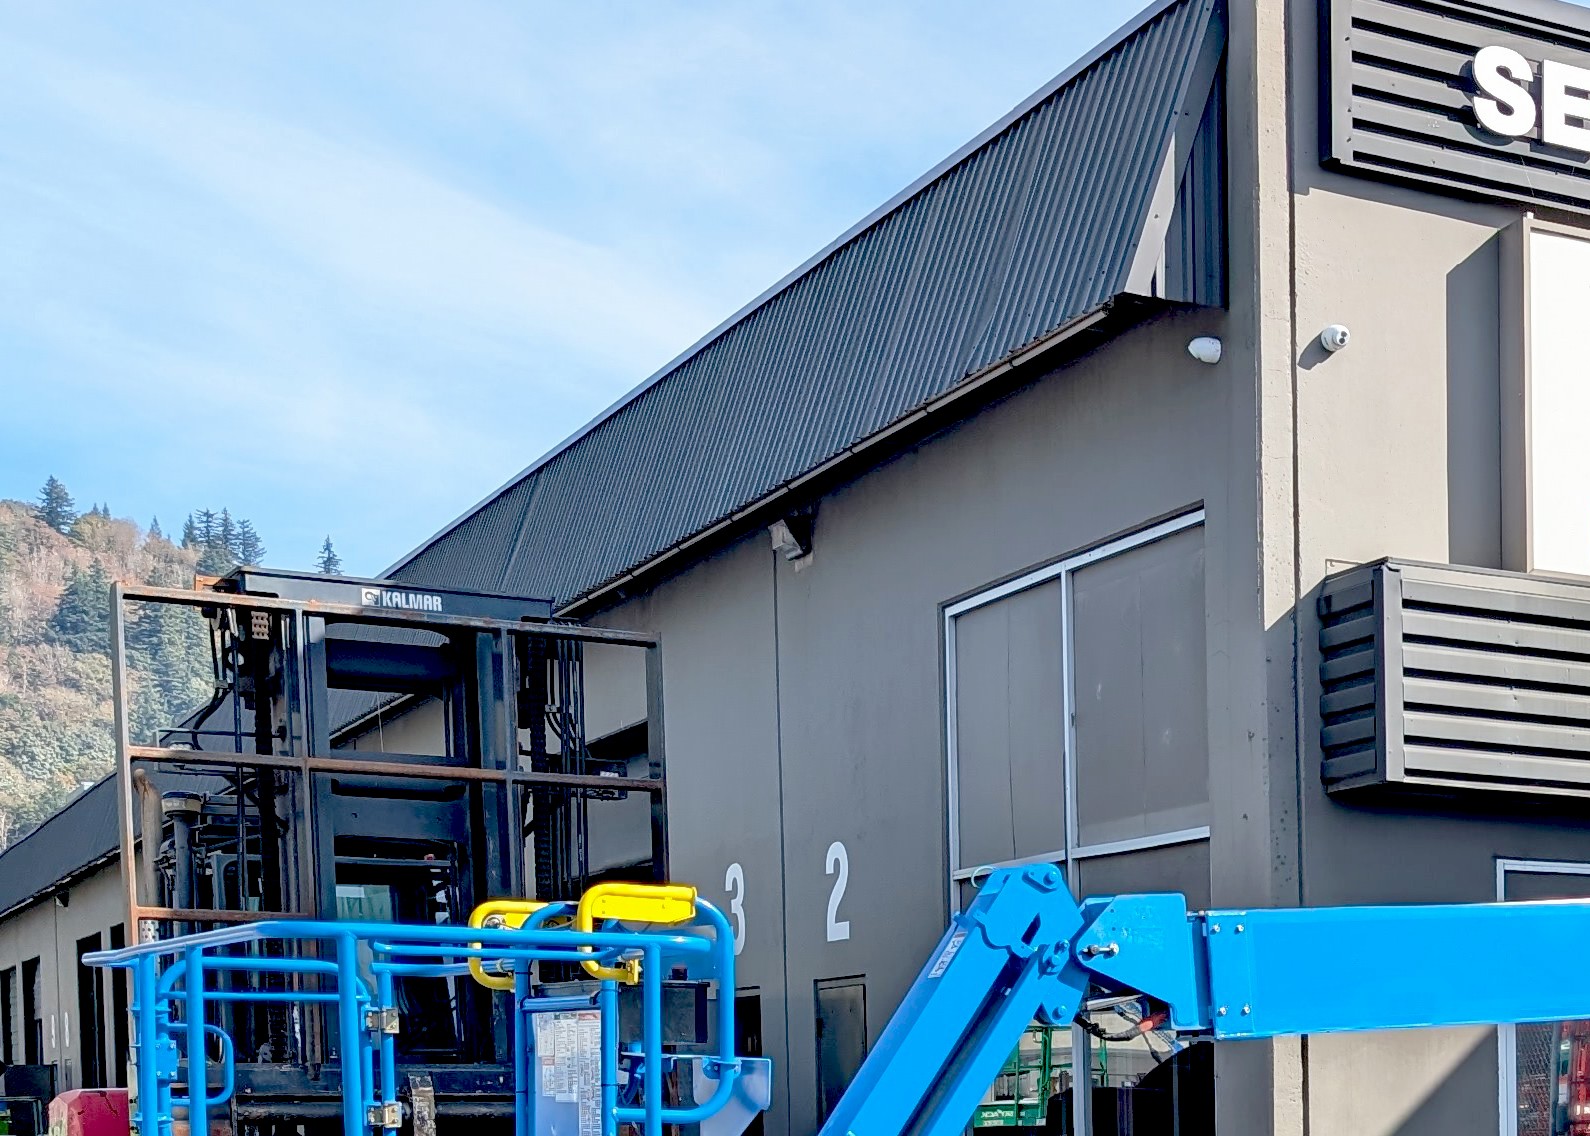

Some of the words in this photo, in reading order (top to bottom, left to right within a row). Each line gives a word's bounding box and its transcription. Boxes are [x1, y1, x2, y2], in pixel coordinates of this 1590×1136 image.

[381, 590, 443, 612] KALMAR
[724, 862, 746, 956] 3
[825, 841, 850, 942] 2
